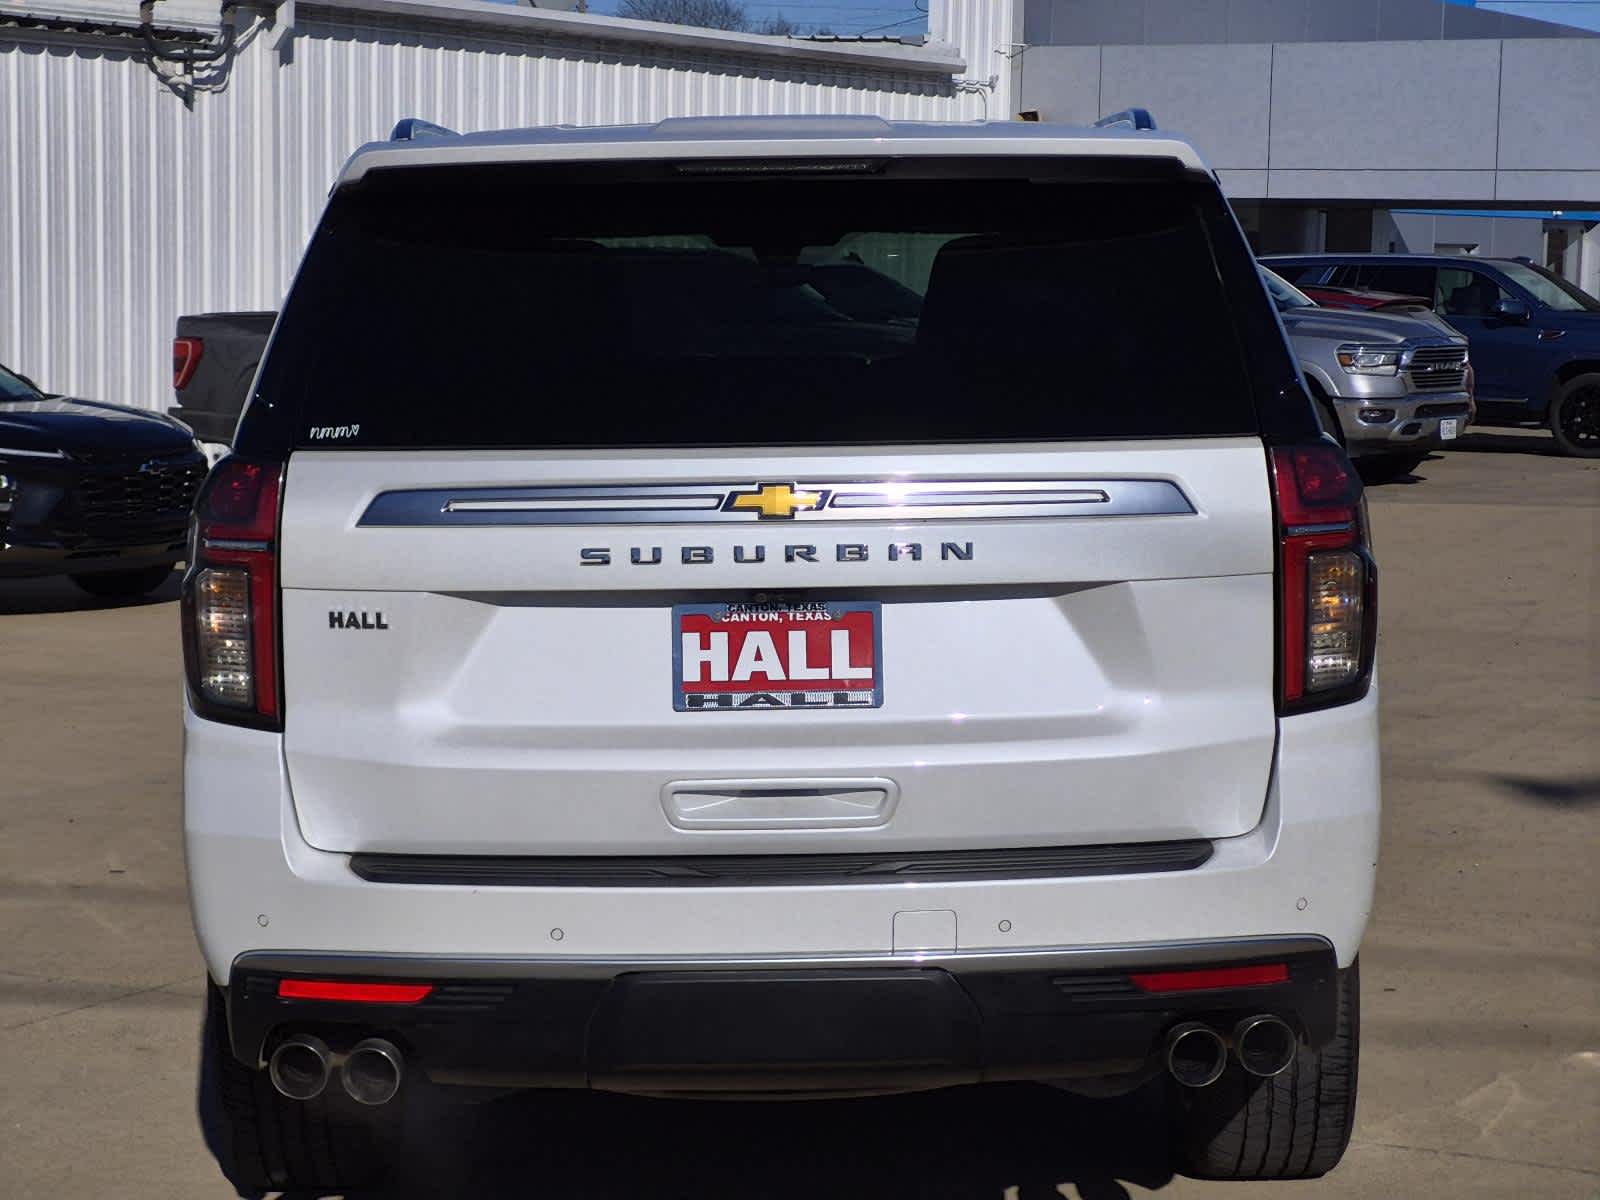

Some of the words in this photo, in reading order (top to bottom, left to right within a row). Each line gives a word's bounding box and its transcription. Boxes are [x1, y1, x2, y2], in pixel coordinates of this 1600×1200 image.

[579, 541, 974, 566] SUBURBAN
[328, 611, 388, 629] HALL
[721, 611, 783, 623] CANTON,
[787, 611, 832, 621] TEXAS
[681, 629, 873, 682] HALL
[687, 692, 870, 707] HALL
